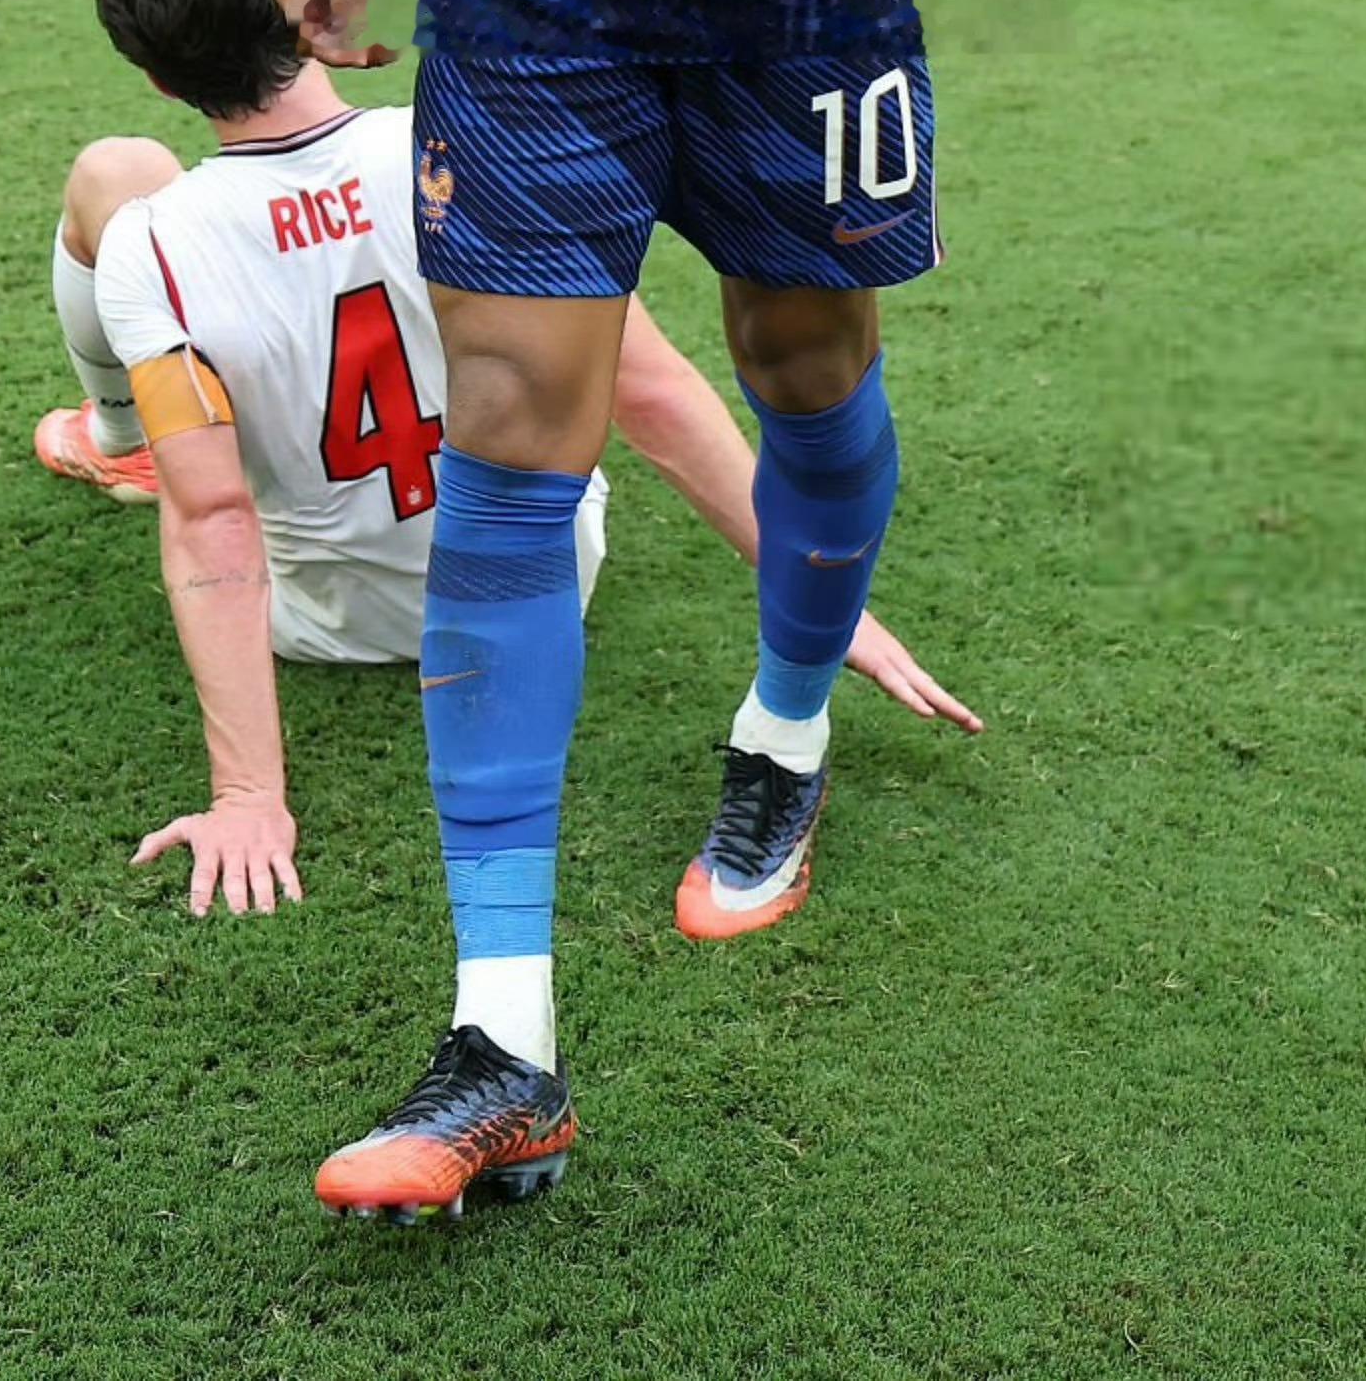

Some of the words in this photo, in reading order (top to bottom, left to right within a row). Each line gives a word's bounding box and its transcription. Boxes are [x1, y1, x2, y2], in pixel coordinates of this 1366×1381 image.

[811, 68, 918, 205] 10
[268, 176, 374, 254] RICE
[319, 280, 445, 523] 4
